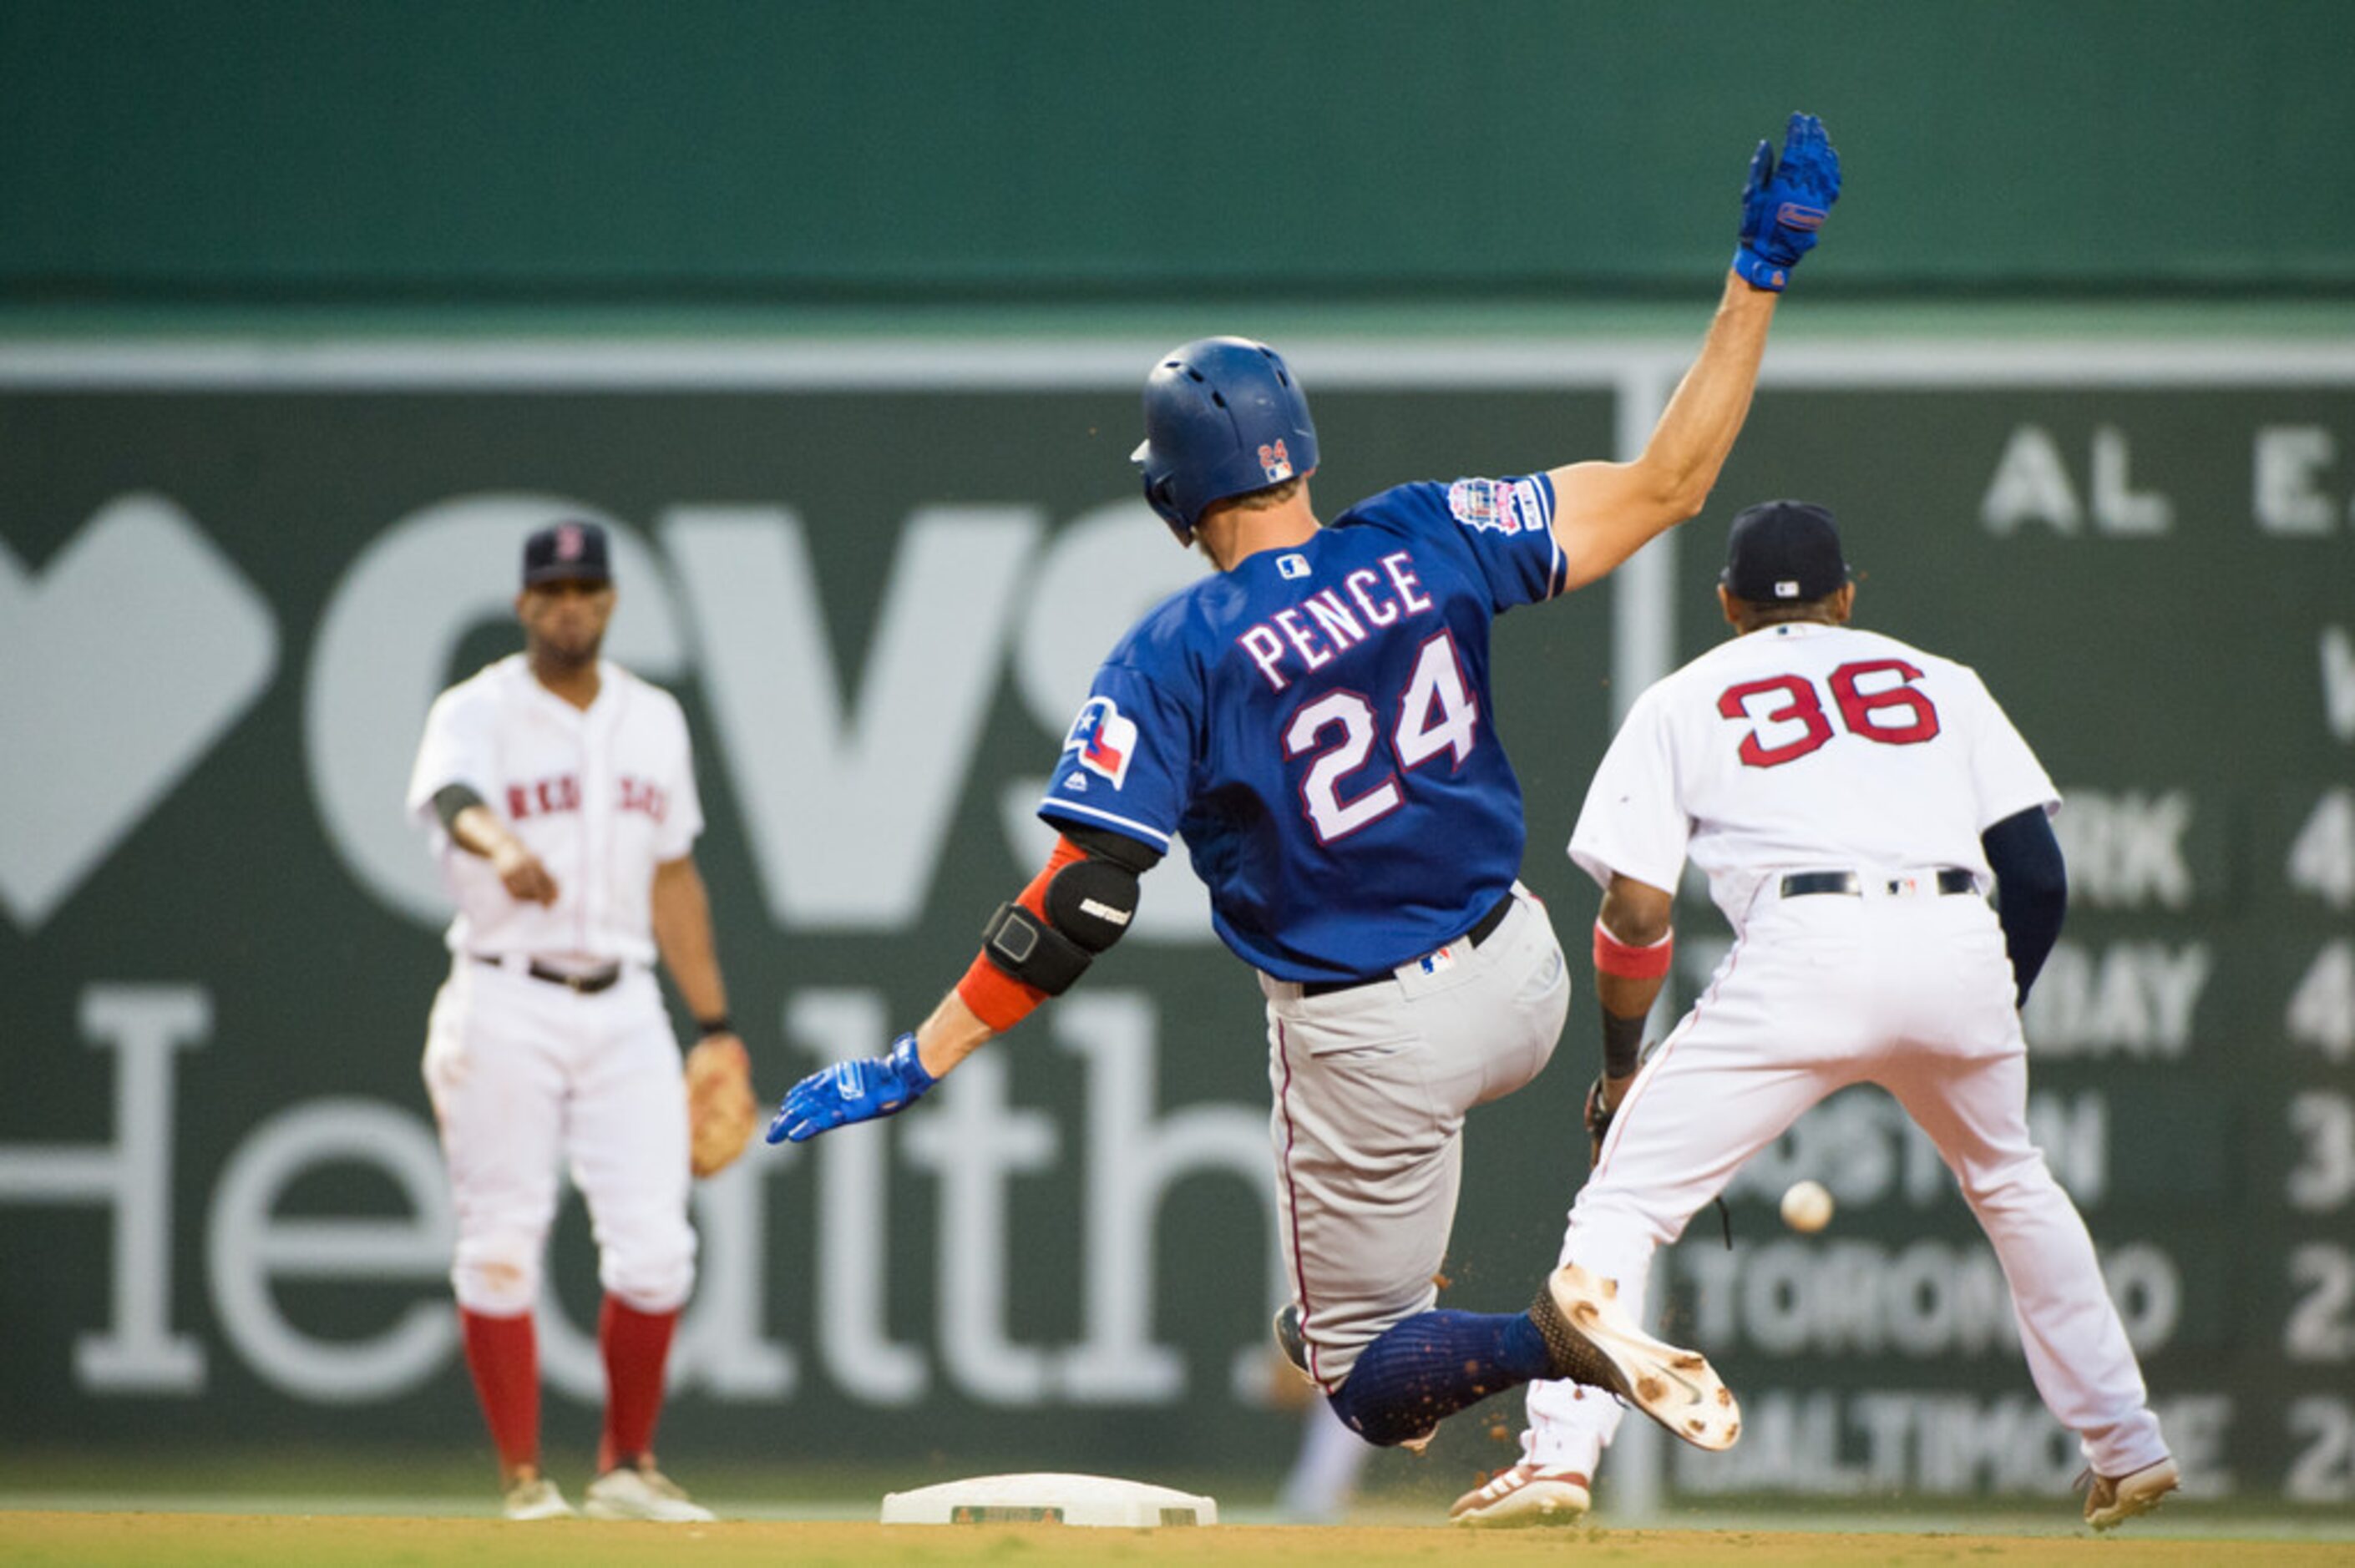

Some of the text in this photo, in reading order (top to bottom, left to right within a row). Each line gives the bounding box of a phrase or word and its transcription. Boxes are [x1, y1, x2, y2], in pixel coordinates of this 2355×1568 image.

[1258, 439, 1288, 468] 24
[1983, 426, 2355, 534] AL E
[1236, 550, 1433, 694] PENCE
[1281, 628, 1478, 847] 24
[1717, 659, 1940, 768] 36
[2288, 791, 2355, 907] 4
[2288, 942, 2355, 1059] 4
[1725, 1085, 2355, 1211] OSTN 3
[1689, 1239, 2355, 1363] TORONO 2
[1675, 1393, 2238, 1500] ALTIMOE
